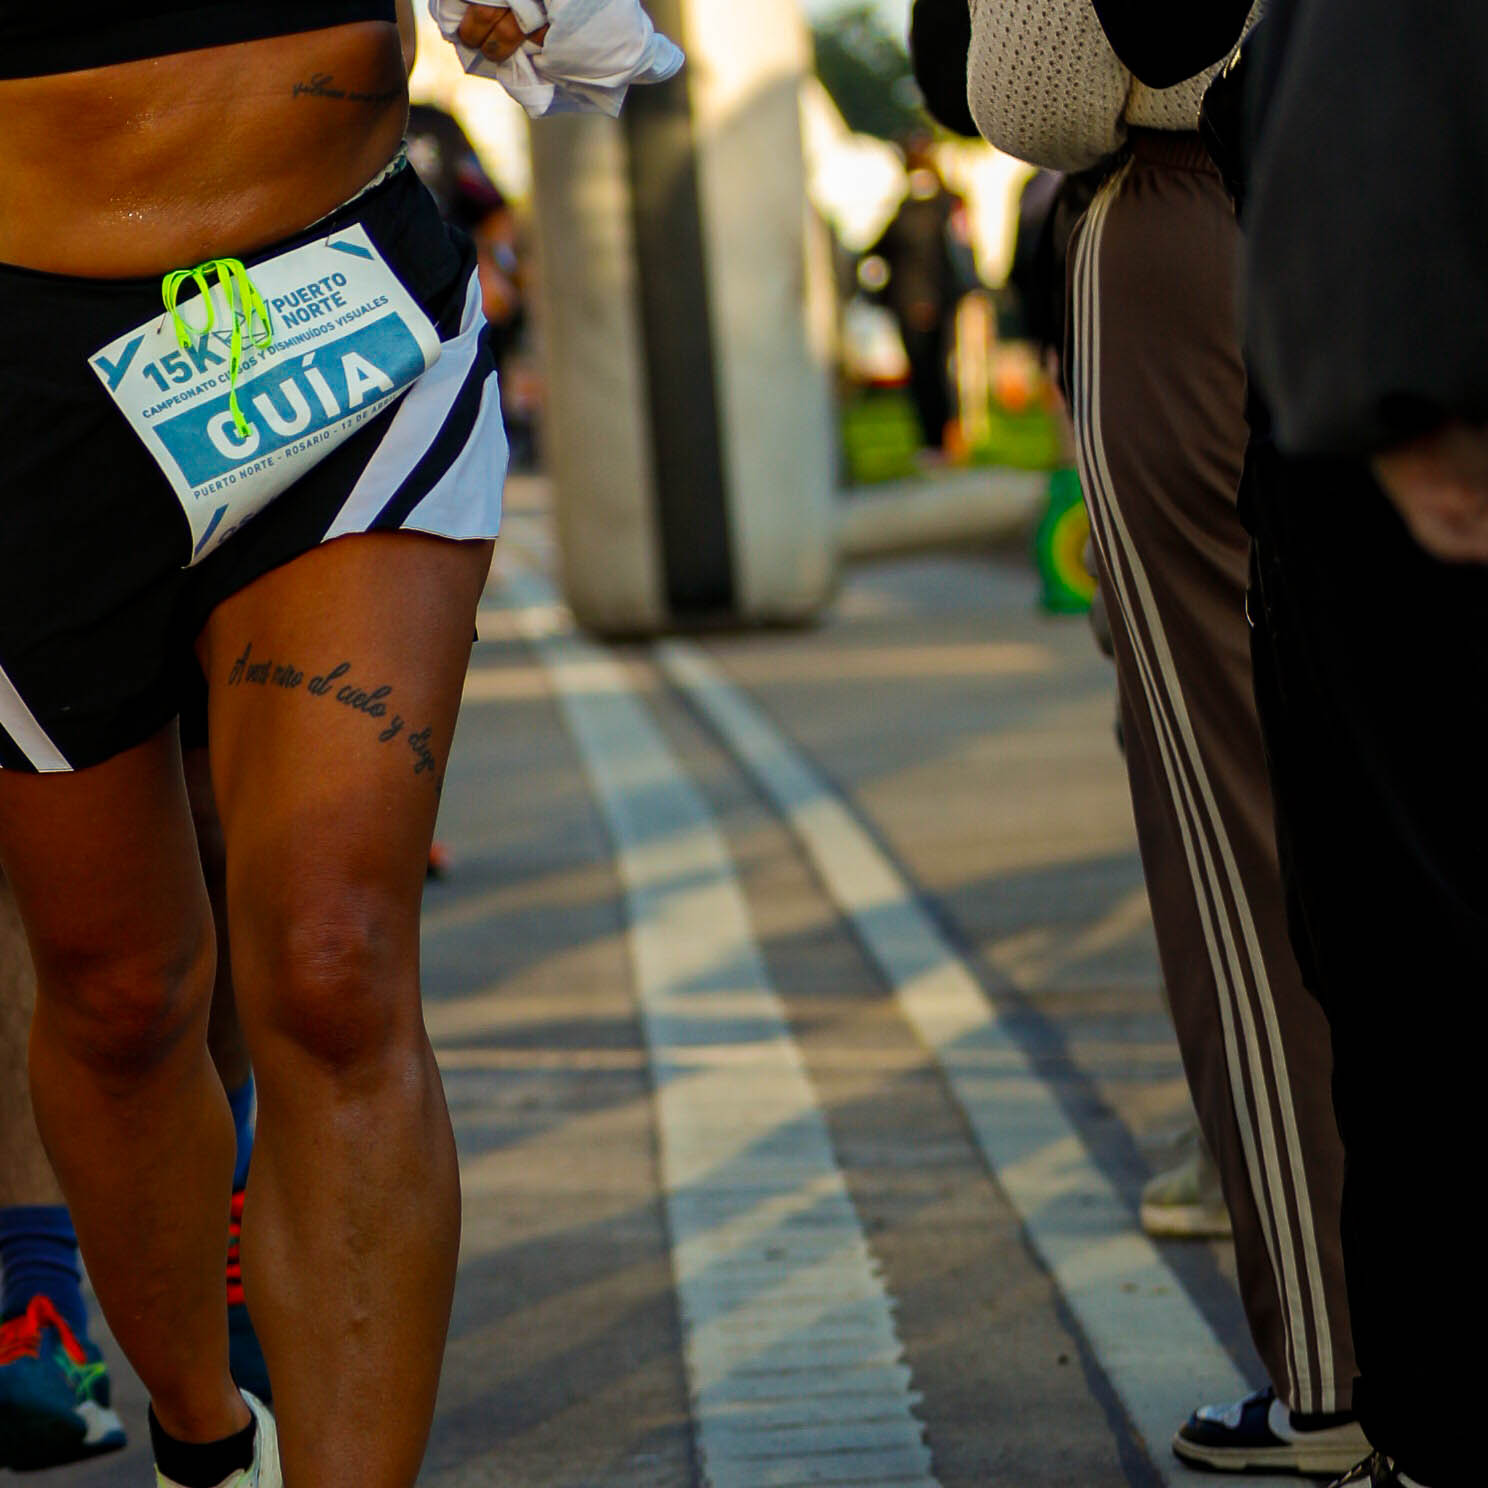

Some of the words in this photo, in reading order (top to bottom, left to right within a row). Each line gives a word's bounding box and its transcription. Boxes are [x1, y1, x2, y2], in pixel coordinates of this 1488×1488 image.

[271, 272, 348, 313] PUERTO
[281, 291, 348, 329] NORTE
[142, 379, 217, 419] CAMPEONATO
[266, 320, 337, 355] DISMINUÍDOS
[336, 295, 390, 328] VISUALES
[142, 334, 225, 393] 15K
[206, 351, 395, 461] GUÍA
[194, 474, 238, 500] PUERTO
[239, 458, 275, 480] NORTE
[285, 431, 330, 458] ROSARIO
[307, 661, 351, 697] al
